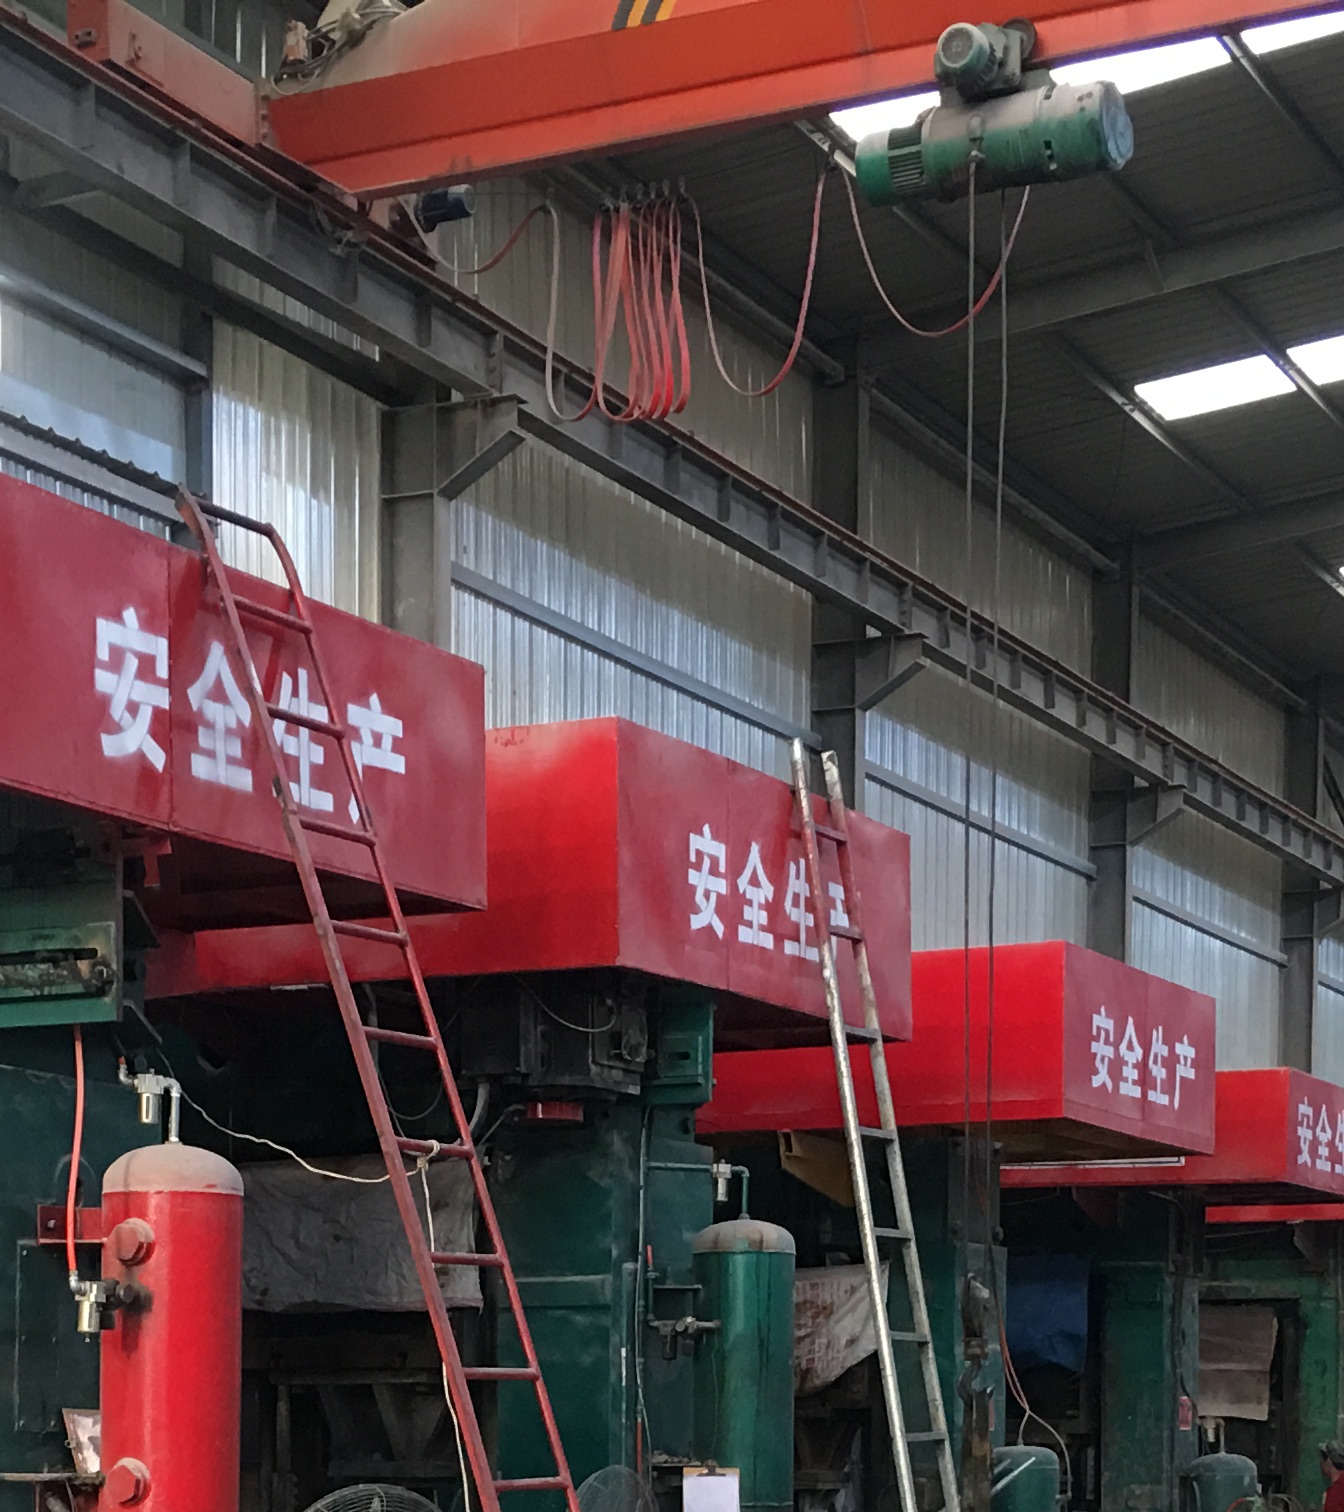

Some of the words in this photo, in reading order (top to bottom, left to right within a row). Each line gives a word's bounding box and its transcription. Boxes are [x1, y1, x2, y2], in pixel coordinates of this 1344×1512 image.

[94, 606, 406, 825] 安全生产
[1090, 1005, 1196, 1111] 安全生产
